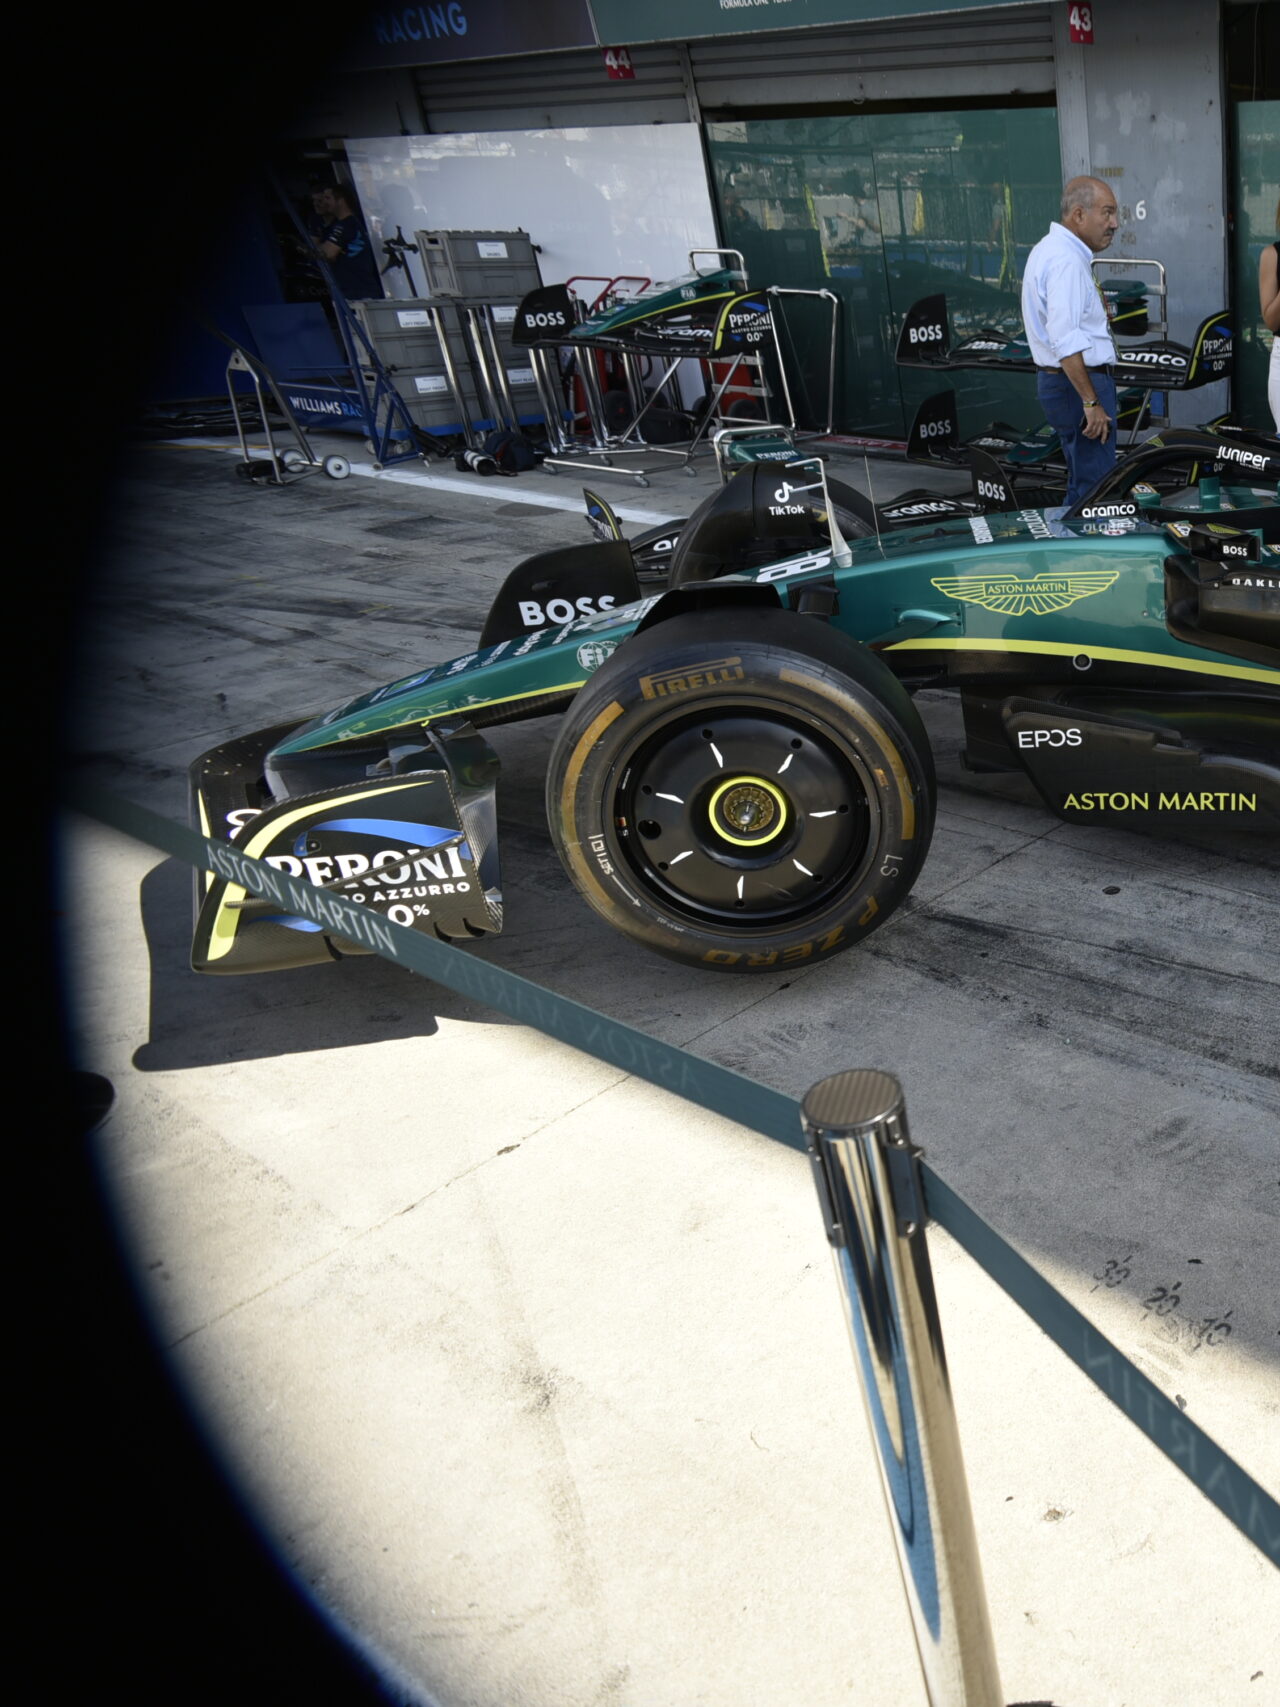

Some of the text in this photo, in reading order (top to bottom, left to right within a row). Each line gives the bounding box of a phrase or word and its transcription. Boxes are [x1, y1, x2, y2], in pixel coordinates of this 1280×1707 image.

[375, 2, 468, 45] RACING
[1070, 6, 1092, 32] 43
[605, 50, 631, 70] 44
[525, 311, 566, 328] BOSS
[909, 324, 943, 343] BOSS
[1121, 352, 1187, 367] amco
[289, 396, 342, 417] WILLIAMS
[919, 419, 952, 438] BOSS
[977, 479, 1006, 502] BOSS
[768, 504, 805, 516] TikTok
[1082, 504, 1136, 518] aramco
[1222, 545, 1248, 557] BOSS
[987, 580, 1067, 594] ASTON MARTIN
[639, 656, 744, 700] PIRELLI
[1017, 727, 1083, 749] EPOS
[1062, 791, 1257, 812] ASTON MARTIN
[880, 854, 903, 878] LS
[206, 843, 398, 957] ASTON MARTIN
[373, 880, 472, 904] AZZURRO
[702, 925, 848, 966] ZERO
